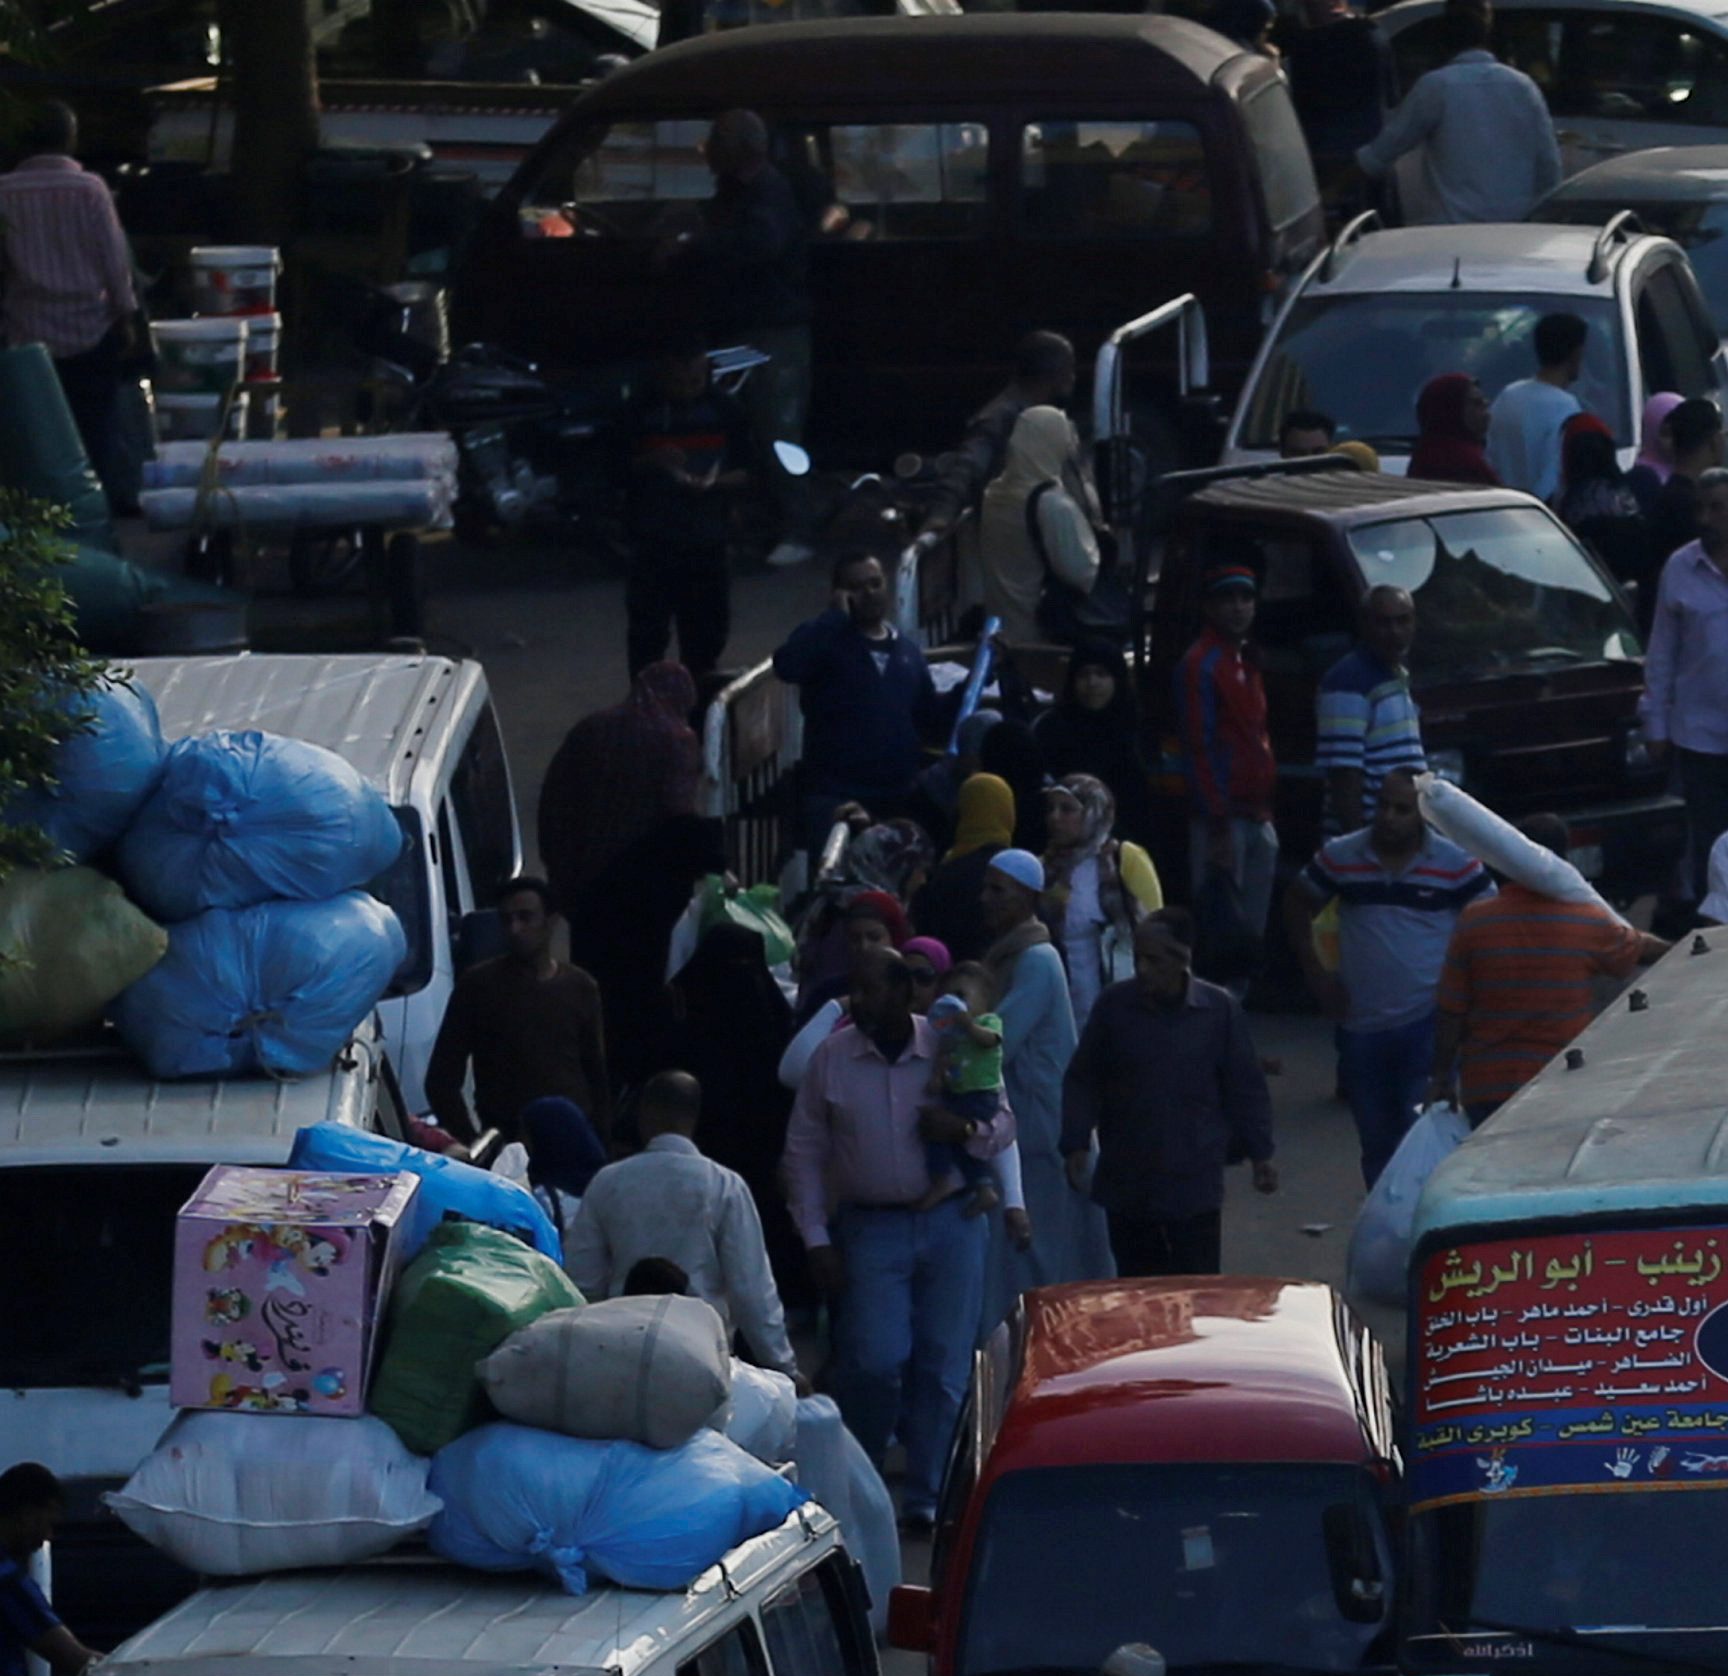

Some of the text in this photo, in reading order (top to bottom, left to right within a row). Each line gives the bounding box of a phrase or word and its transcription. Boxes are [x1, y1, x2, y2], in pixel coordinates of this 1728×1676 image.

[1540, 1241, 1593, 1292] أبو
[1637, 1238, 1721, 1286] زينب
[1429, 1249, 1533, 1302] الريش
[1465, 1306, 1499, 1328] باب
[1518, 1303, 1560, 1323] ماهر
[1563, 1297, 1608, 1318] أحمد
[1425, 1325, 1685, 1362] جامع البنات باب الشعرية
[1526, 1359, 1594, 1378] ميدان
[1426, 1384, 1504, 1412] باشا
[1593, 1381, 1661, 1400] سعيد
[1557, 1411, 1615, 1439] شمس
[1620, 1413, 1661, 1437] عين
